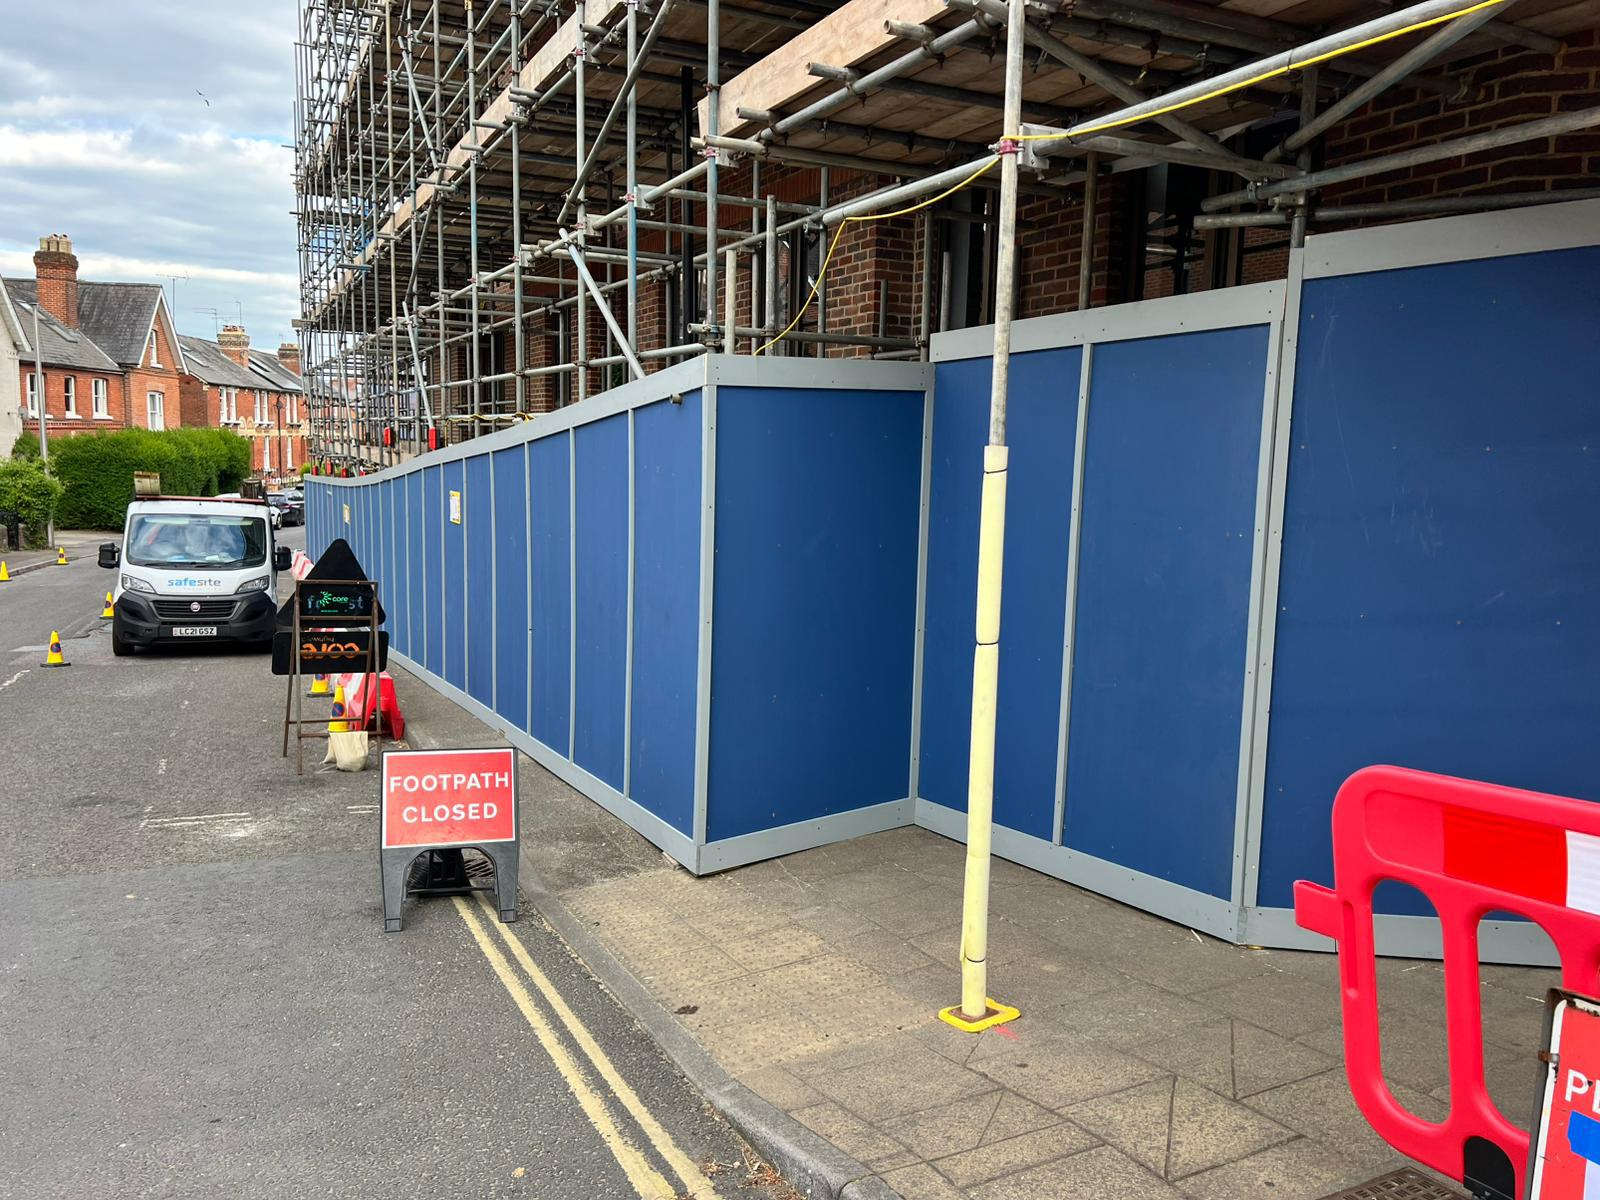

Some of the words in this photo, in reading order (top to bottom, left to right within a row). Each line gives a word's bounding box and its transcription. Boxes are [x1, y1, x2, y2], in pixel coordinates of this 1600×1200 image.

[167, 577, 222, 587] safesite
[179, 627, 197, 635] LC21
[198, 627, 215, 635] GSZ
[301, 642, 361, 659] core
[389, 772, 509, 793] FOOTPATH
[402, 802, 498, 823] CLOSED
